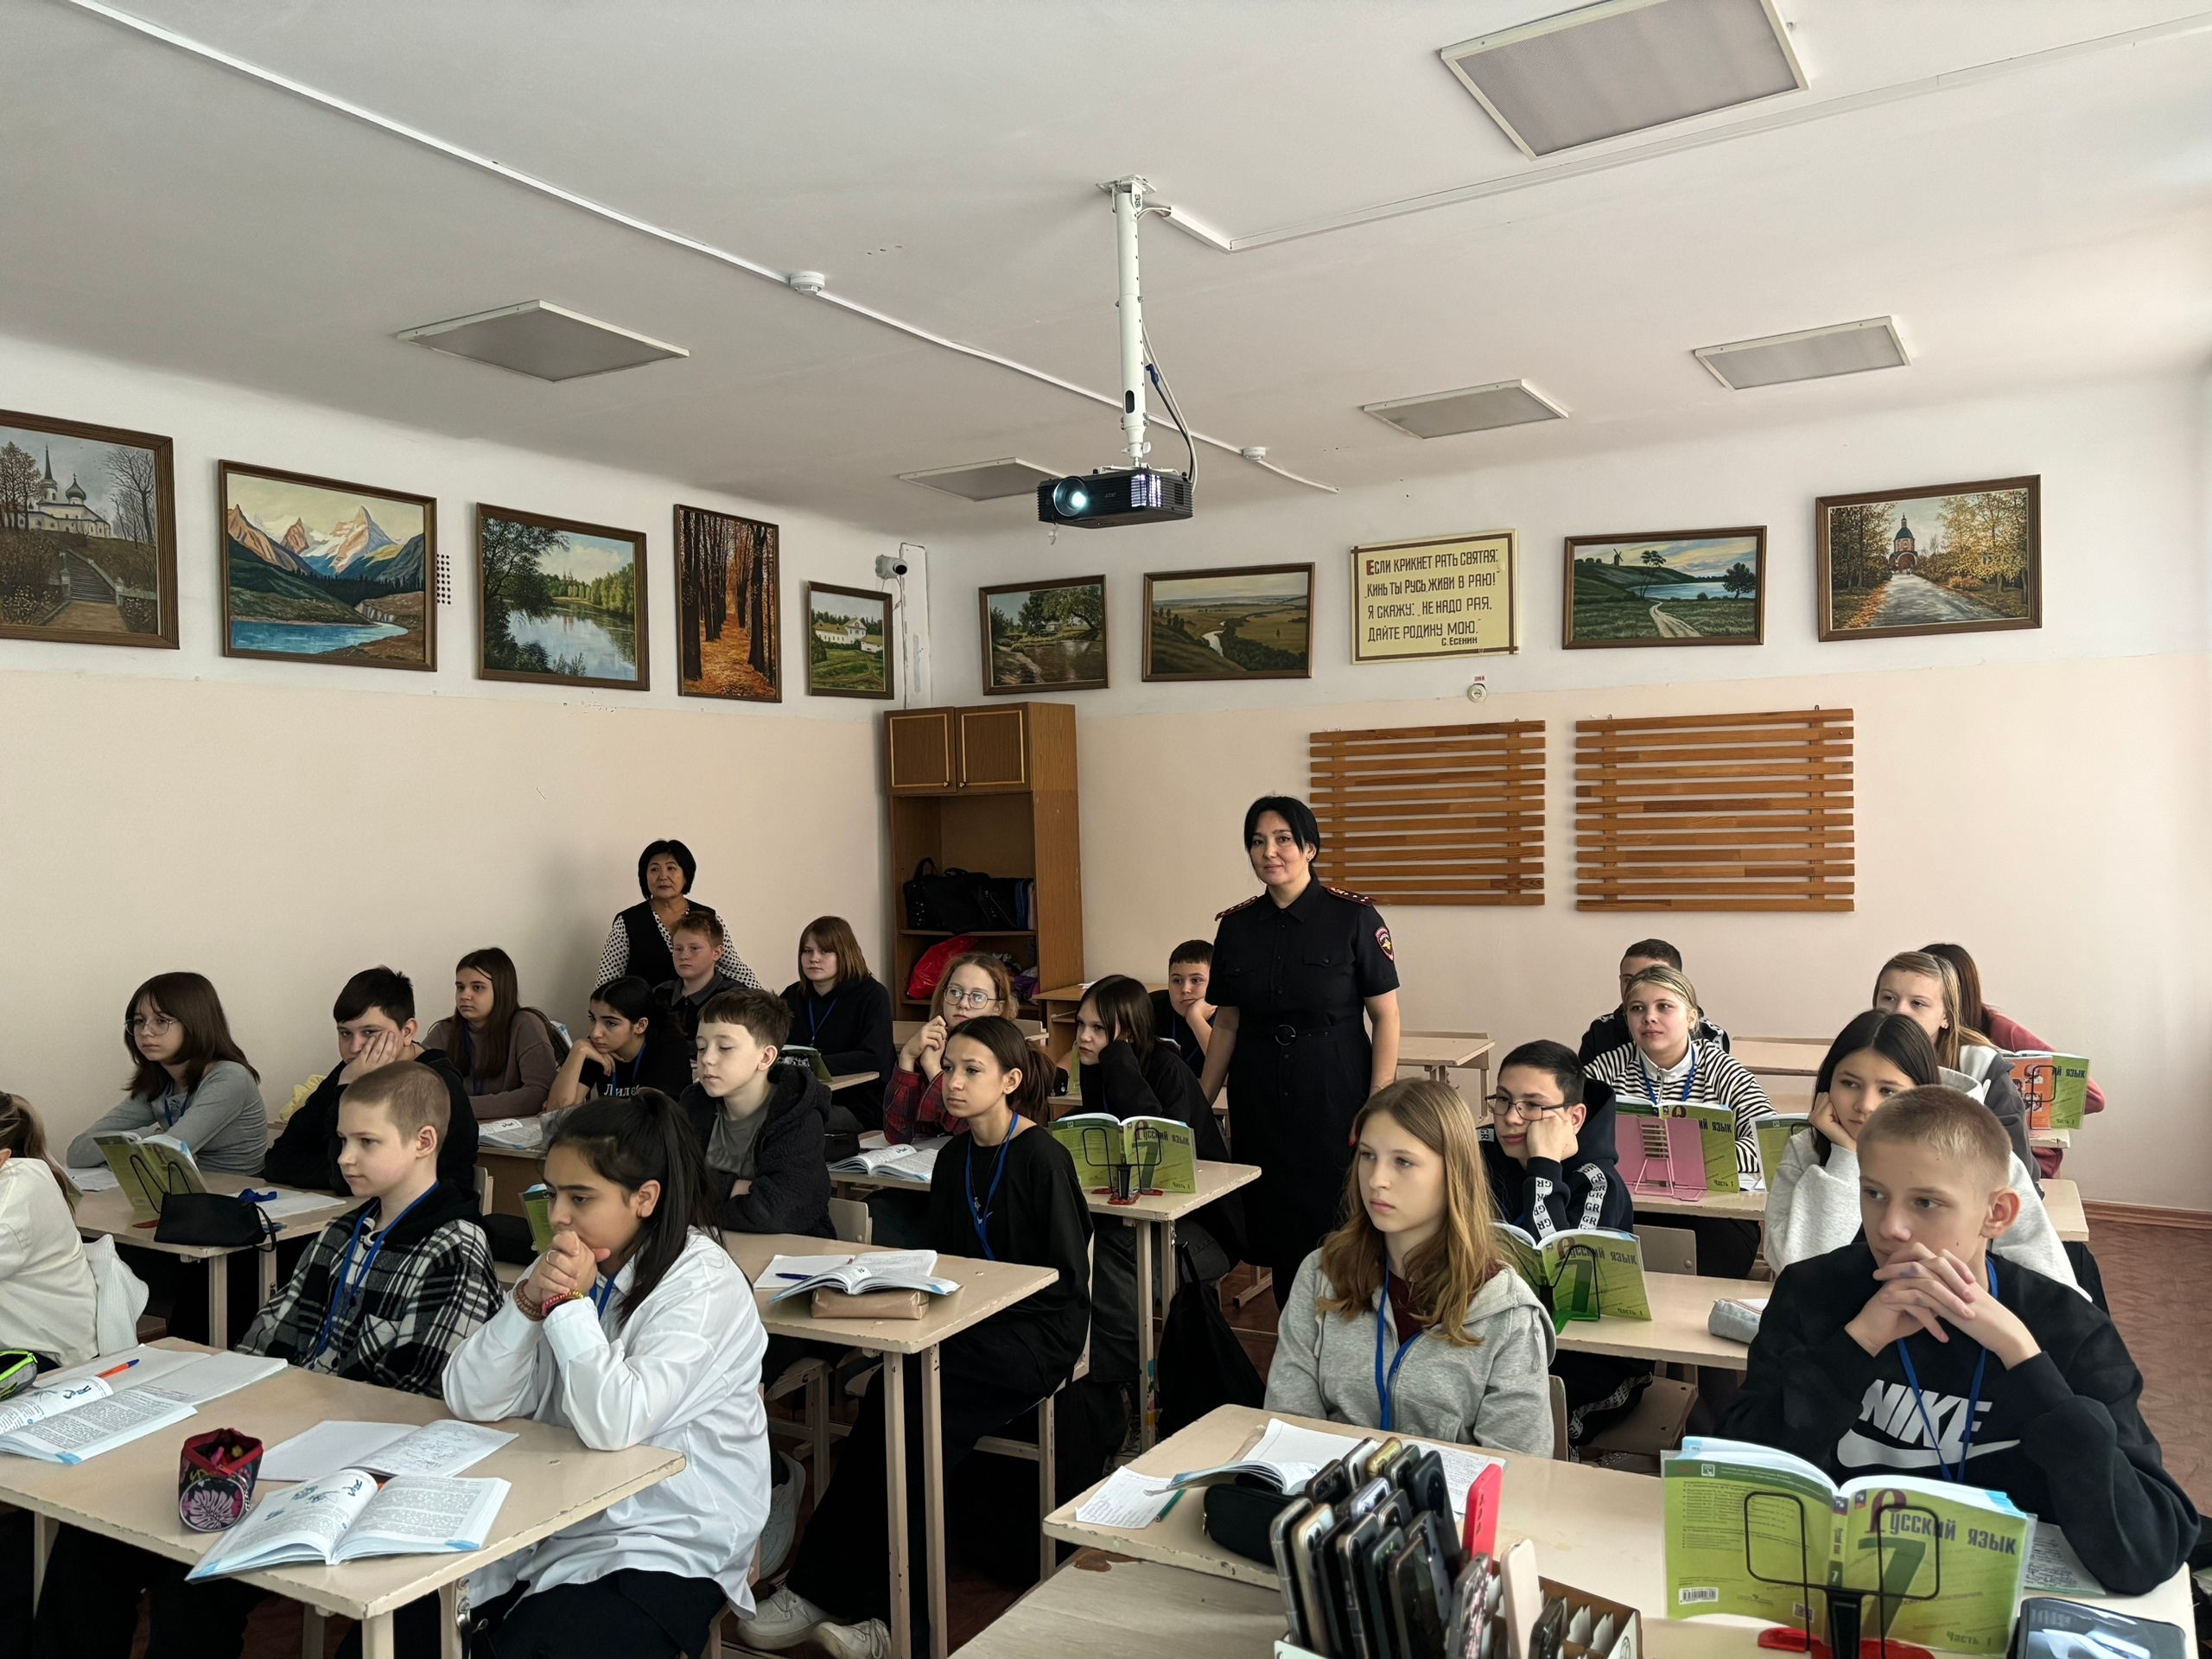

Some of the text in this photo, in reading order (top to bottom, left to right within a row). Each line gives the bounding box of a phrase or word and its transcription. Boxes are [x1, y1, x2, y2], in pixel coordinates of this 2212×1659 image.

[1393, 556, 1433, 572] КРИКНЕТ
[1434, 552, 1458, 568] РАТЬ
[1459, 549, 1498, 566] СВЯТАЯ:
[1389, 582, 1402, 595] ТЫ
[1428, 576, 1455, 592] ЖИВИ
[1458, 575, 1465, 588] В
[1368, 605, 1374, 620] Я
[1377, 602, 1414, 619] СКАЖУ:
[1435, 599, 1462, 615] НАДО
[1367, 625, 1400, 643] ДАЙТЕ
[1402, 623, 1443, 639] РОДИНУ
[1591, 1173, 1605, 1185] GR
[1585, 1202, 1600, 1213] GR
[1582, 1216, 1597, 1226] GR
[1610, 1251, 1637, 1265] язык
[1859, 1379, 1993, 1451] NIKE
[1967, 1529, 2016, 1554] язык
[1832, 1570, 1839, 1582] 7
[1858, 1537, 1926, 1641] 7
